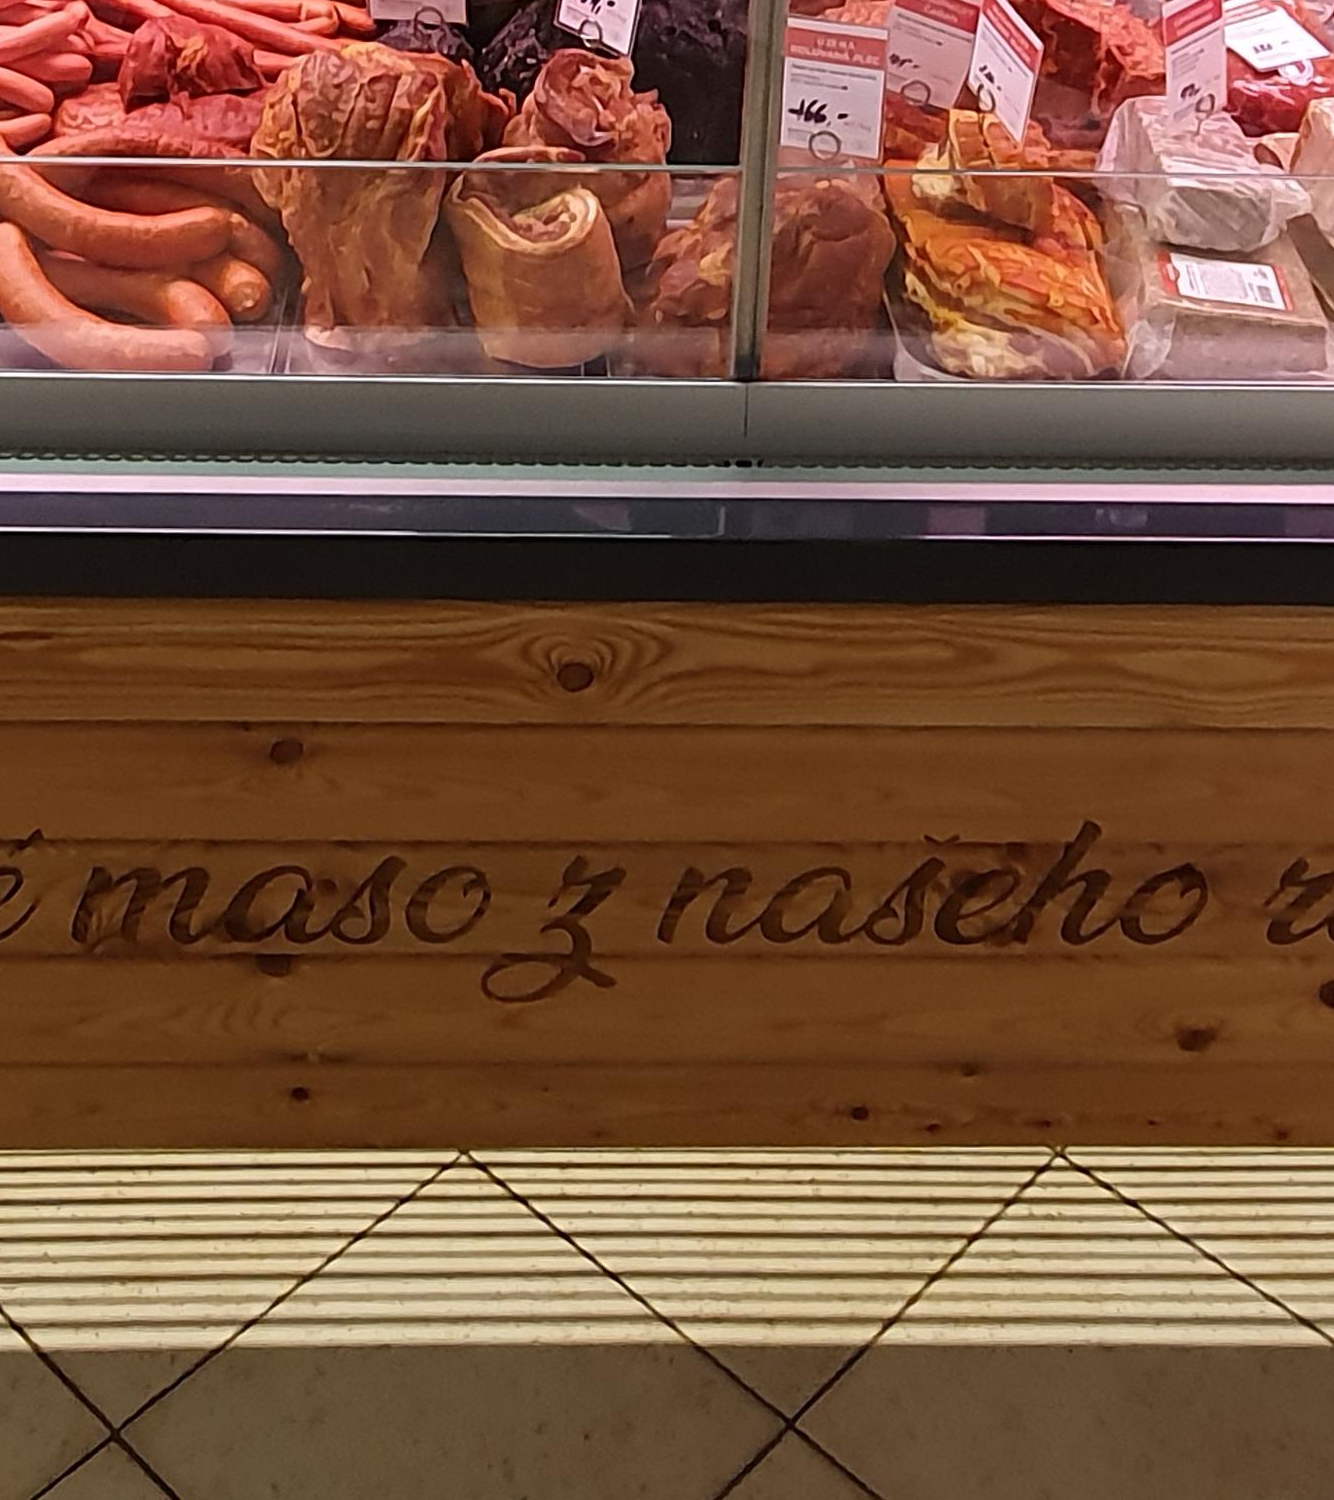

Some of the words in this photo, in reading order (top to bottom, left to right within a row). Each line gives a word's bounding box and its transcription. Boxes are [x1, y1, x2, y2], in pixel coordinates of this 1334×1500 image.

[70, 854, 492, 946] maso
[480, 854, 629, 1003] z
[656, 819, 1209, 946] našeho
